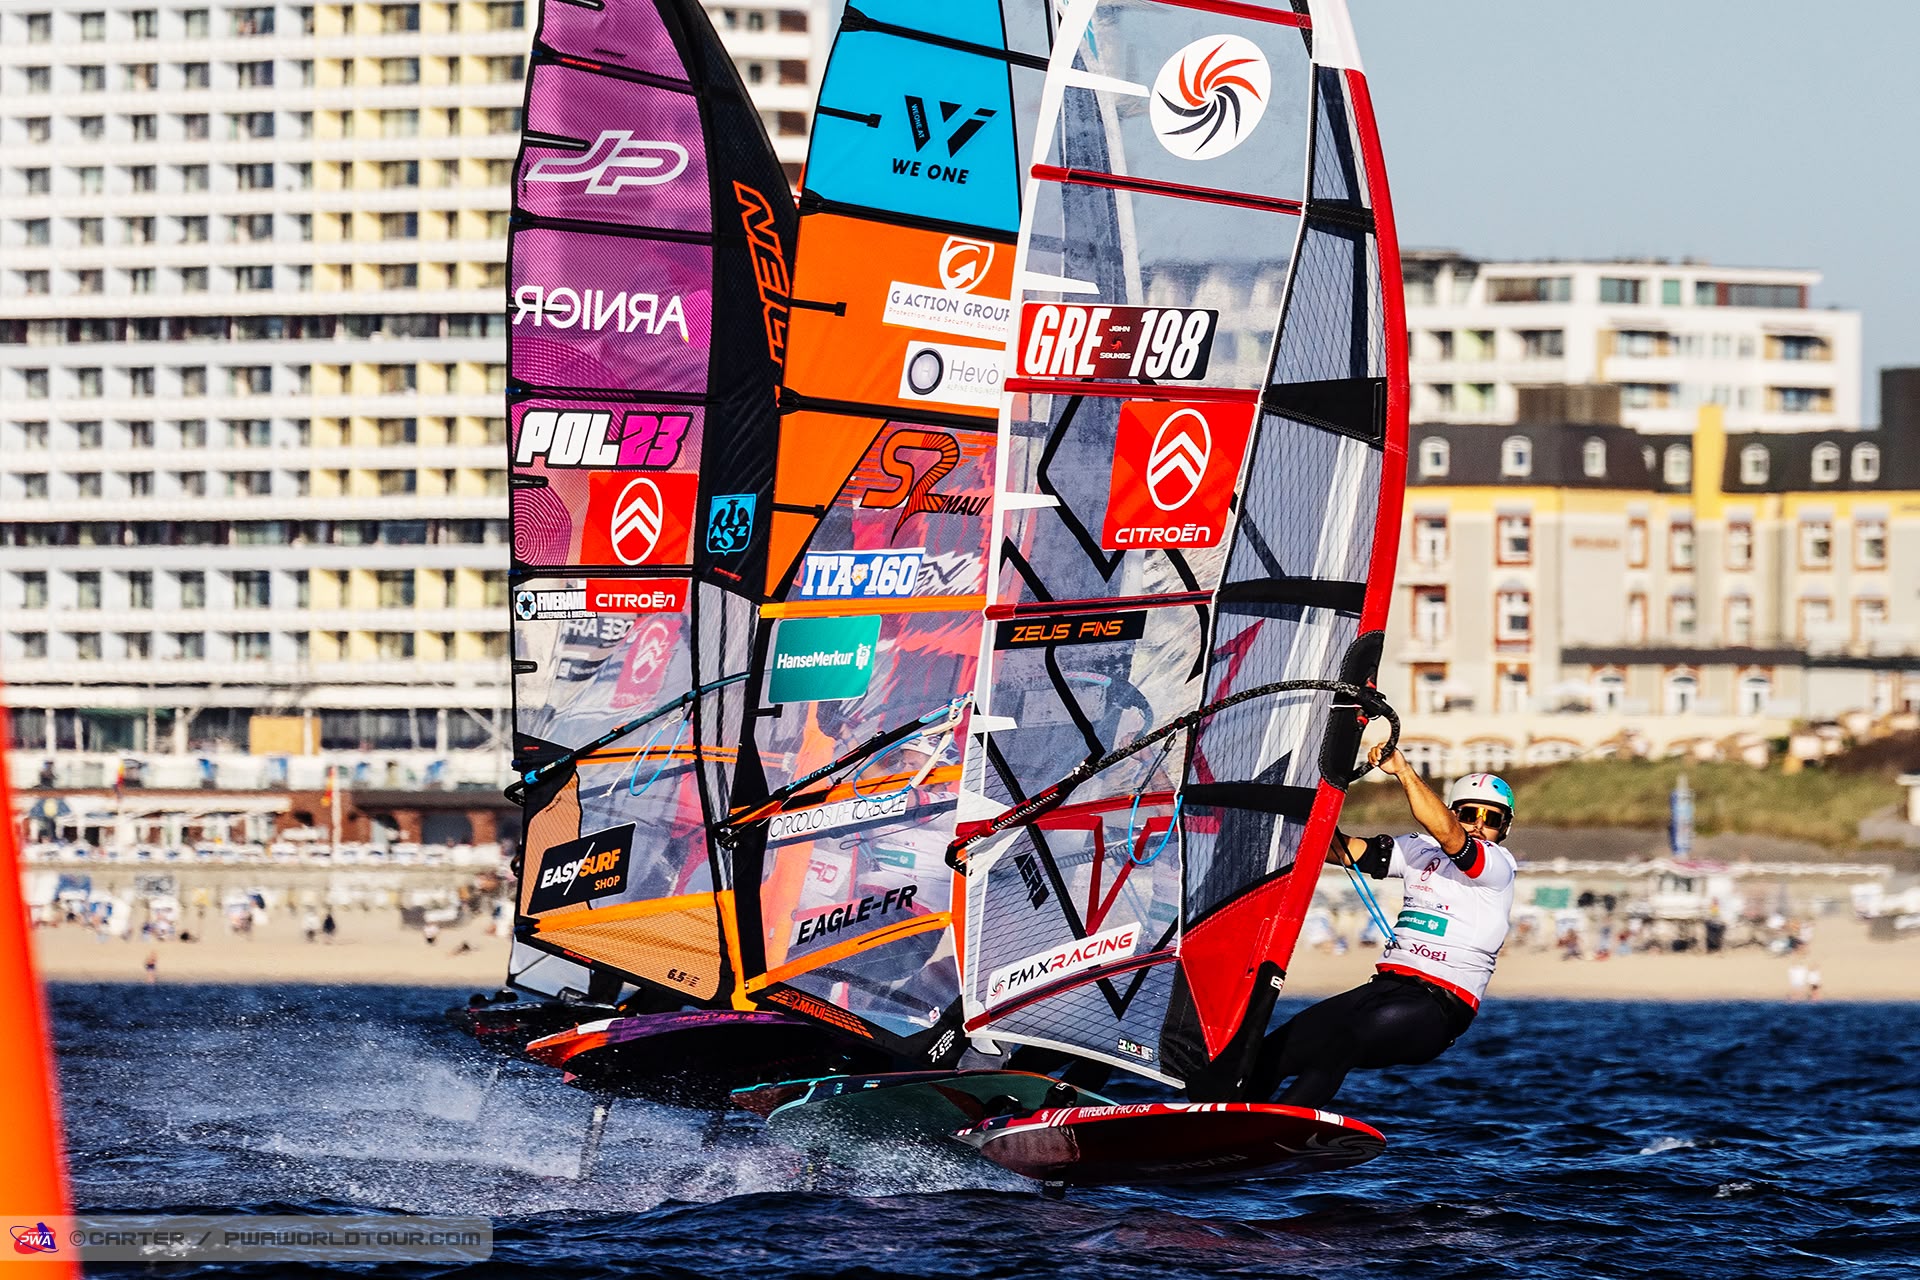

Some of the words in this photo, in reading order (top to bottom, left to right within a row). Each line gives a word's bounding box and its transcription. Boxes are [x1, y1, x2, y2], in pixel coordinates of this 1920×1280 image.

[892, 158, 921, 177] WE
[927, 164, 969, 184] ONE
[891, 290, 900, 304] G
[904, 294, 959, 313] ACTION
[944, 316, 973, 328] Security
[1109, 325, 1131, 333] JOHN
[1024, 305, 1112, 376] GRE
[1128, 309, 1210, 378] 198
[940, 495, 992, 517] MAUI
[801, 556, 854, 596] ITA
[864, 556, 921, 596] 160
[1010, 623, 1072, 642] ZEUS
[1078, 620, 1124, 638] FINS
[777, 650, 853, 669] HanseMerkur
[594, 875, 620, 891] SHOP
[796, 885, 918, 945] EAGLE-FR
[1409, 943, 1447, 962] Yogi
[667, 968, 688, 983] 6.5
[799, 1000, 827, 1020] MAUI
[931, 1043, 945, 1063] 7.5
